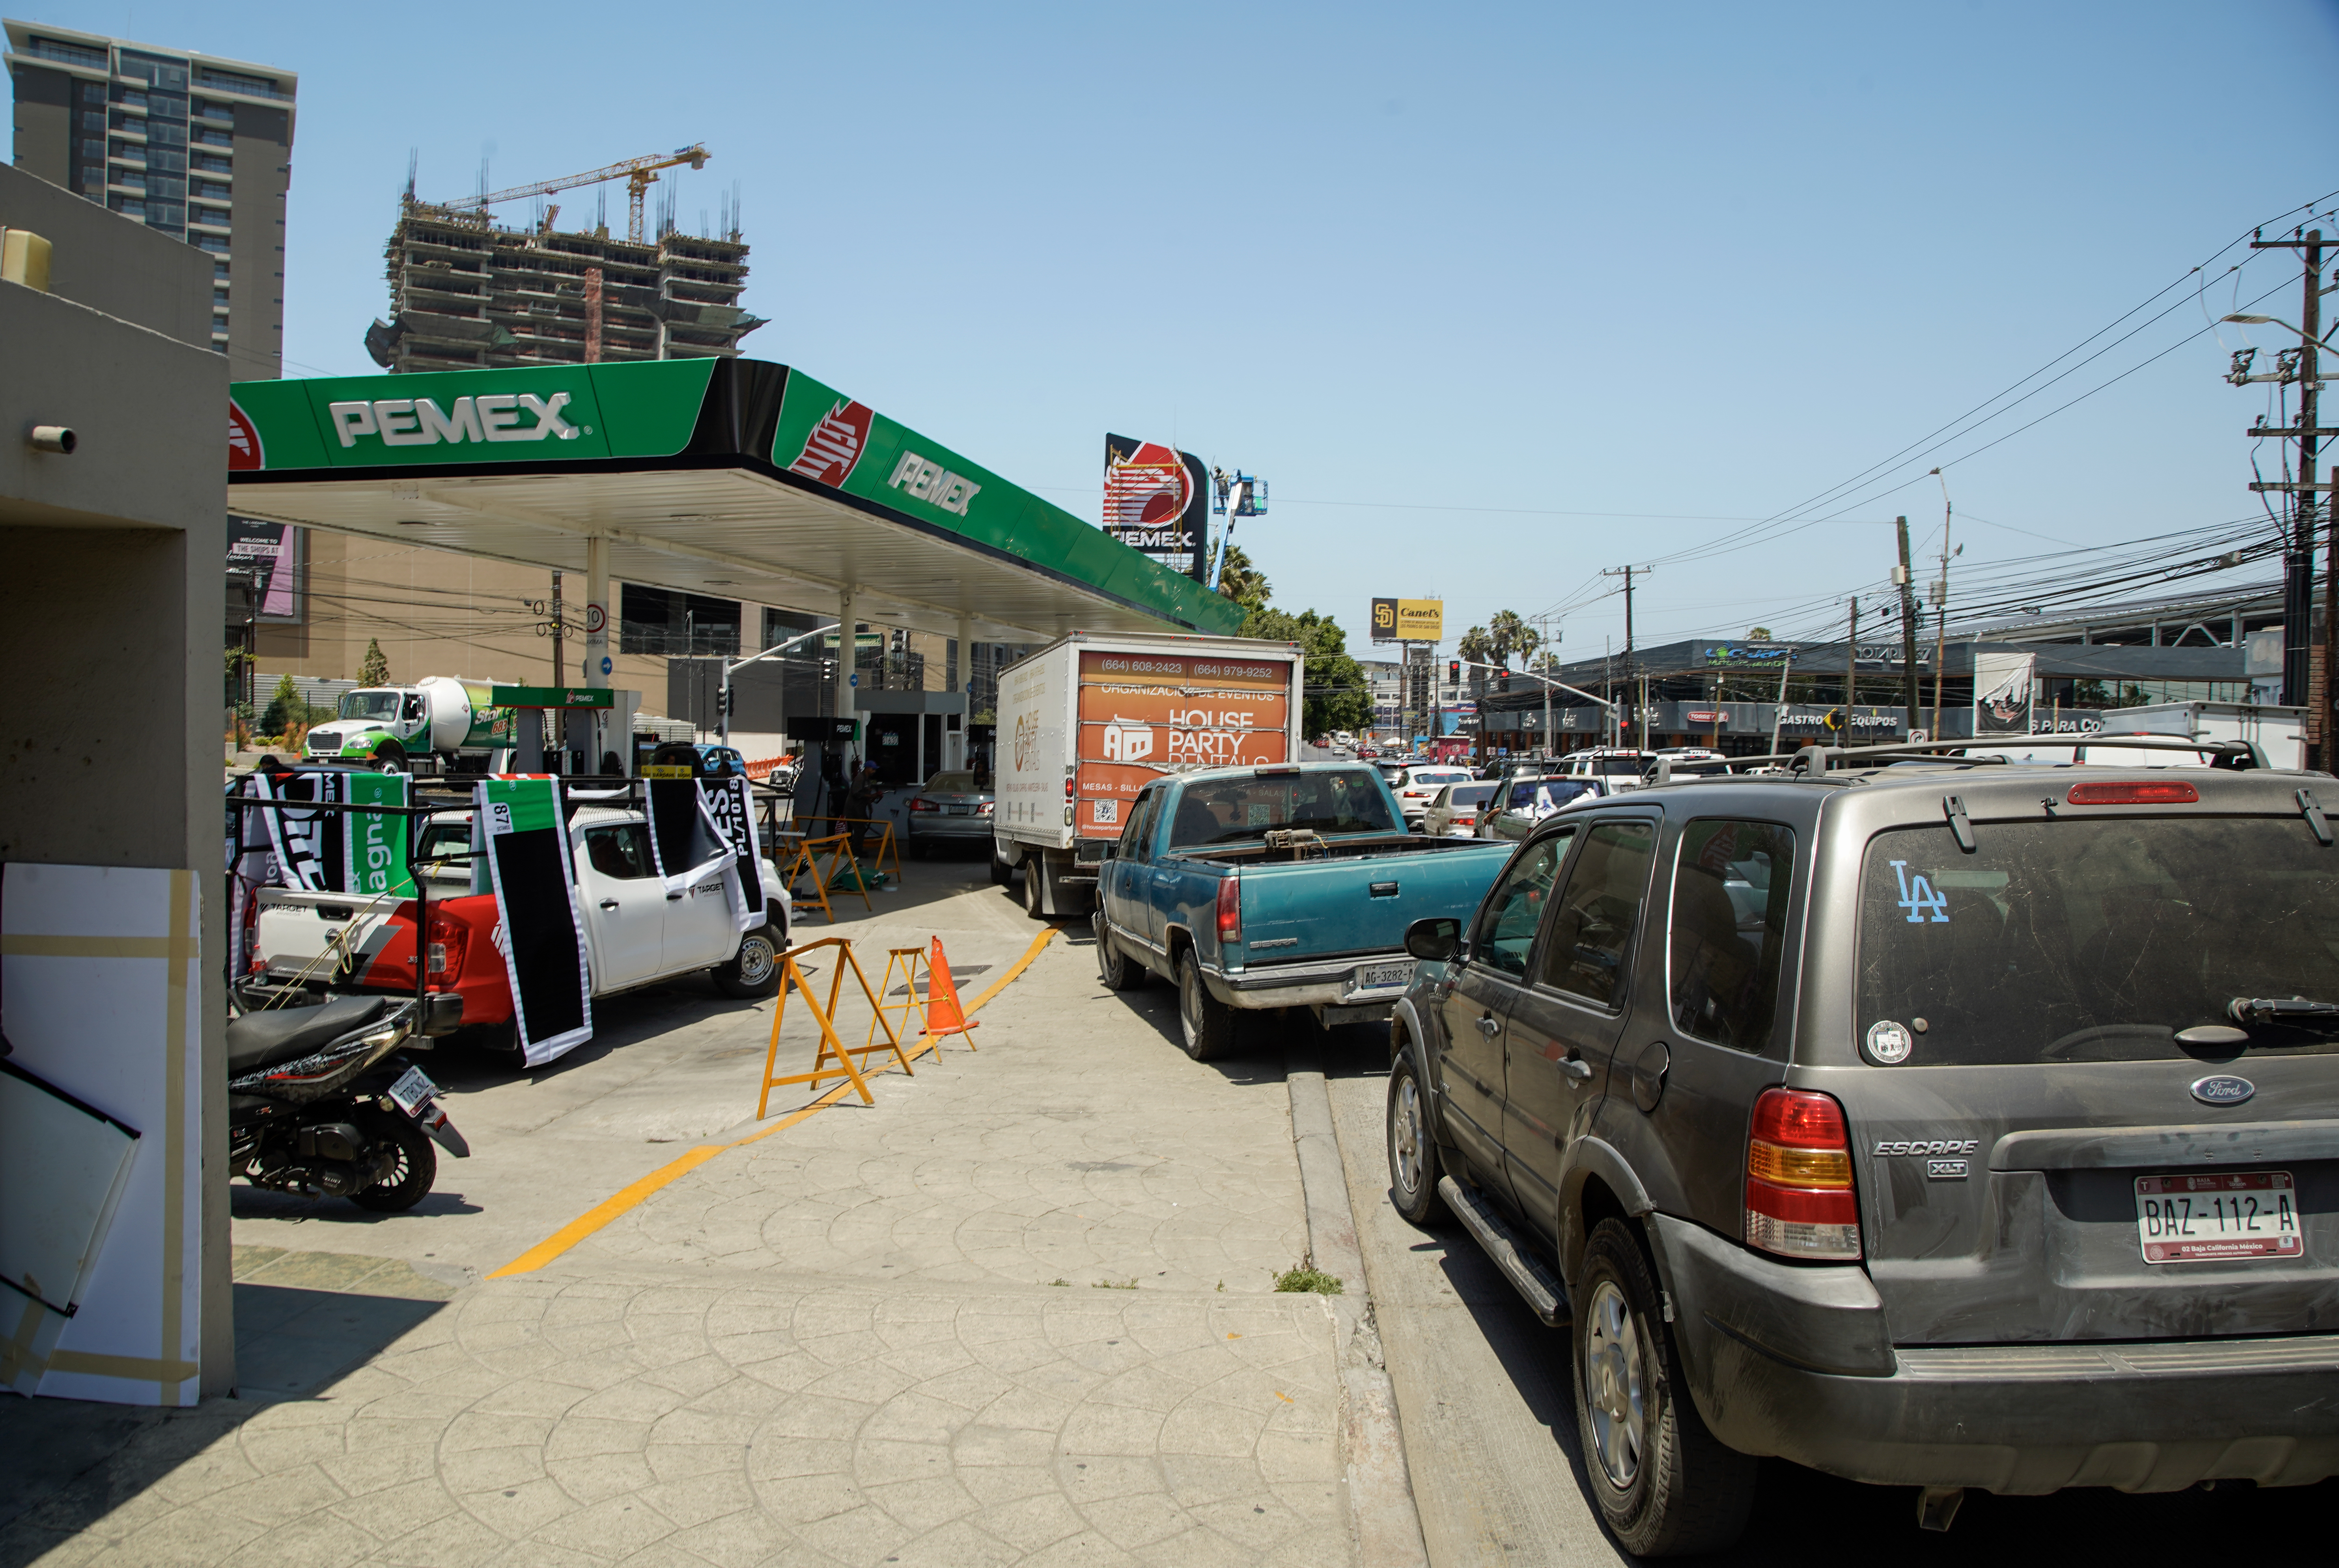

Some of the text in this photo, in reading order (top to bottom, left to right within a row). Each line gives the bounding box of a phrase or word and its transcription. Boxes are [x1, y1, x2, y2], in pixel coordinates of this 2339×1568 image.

[329, 392, 579, 447] PEMEX
[887, 450, 982, 517] PEMEX
[250, 545, 270, 554] SHOPS
[1401, 608, 1440, 618] Canel's
[1101, 659, 1273, 678] (664) 608-2423 (664) 979-9252
[607, 694, 611, 705] 1
[475, 708, 502, 725] Star
[1170, 709, 1254, 733] HOUSE
[1779, 714, 1898, 727] GASTRO EQUIPOS
[492, 719, 508, 735] 683
[1169, 731, 1247, 755] PARTY
[1083, 782, 1112, 791] MESAS
[494, 805, 509, 823] 87
[366, 799, 392, 894] agna
[697, 882, 724, 894] TARGET
[1889, 860, 1949, 922] LA
[271, 903, 308, 913] TARGET
[1249, 938, 1297, 949] SIERRA
[1365, 968, 1413, 984] AG-3282-A
[1891, 1023, 1906, 1034] ANGELES
[2207, 1081, 2241, 1097] Ford
[1873, 1140, 1978, 1157] ESCAPE
[1931, 1163, 1964, 1174] XLT
[2141, 1182, 2148, 1191] T
[2145, 1195, 2294, 1237] BAZ-112-A
